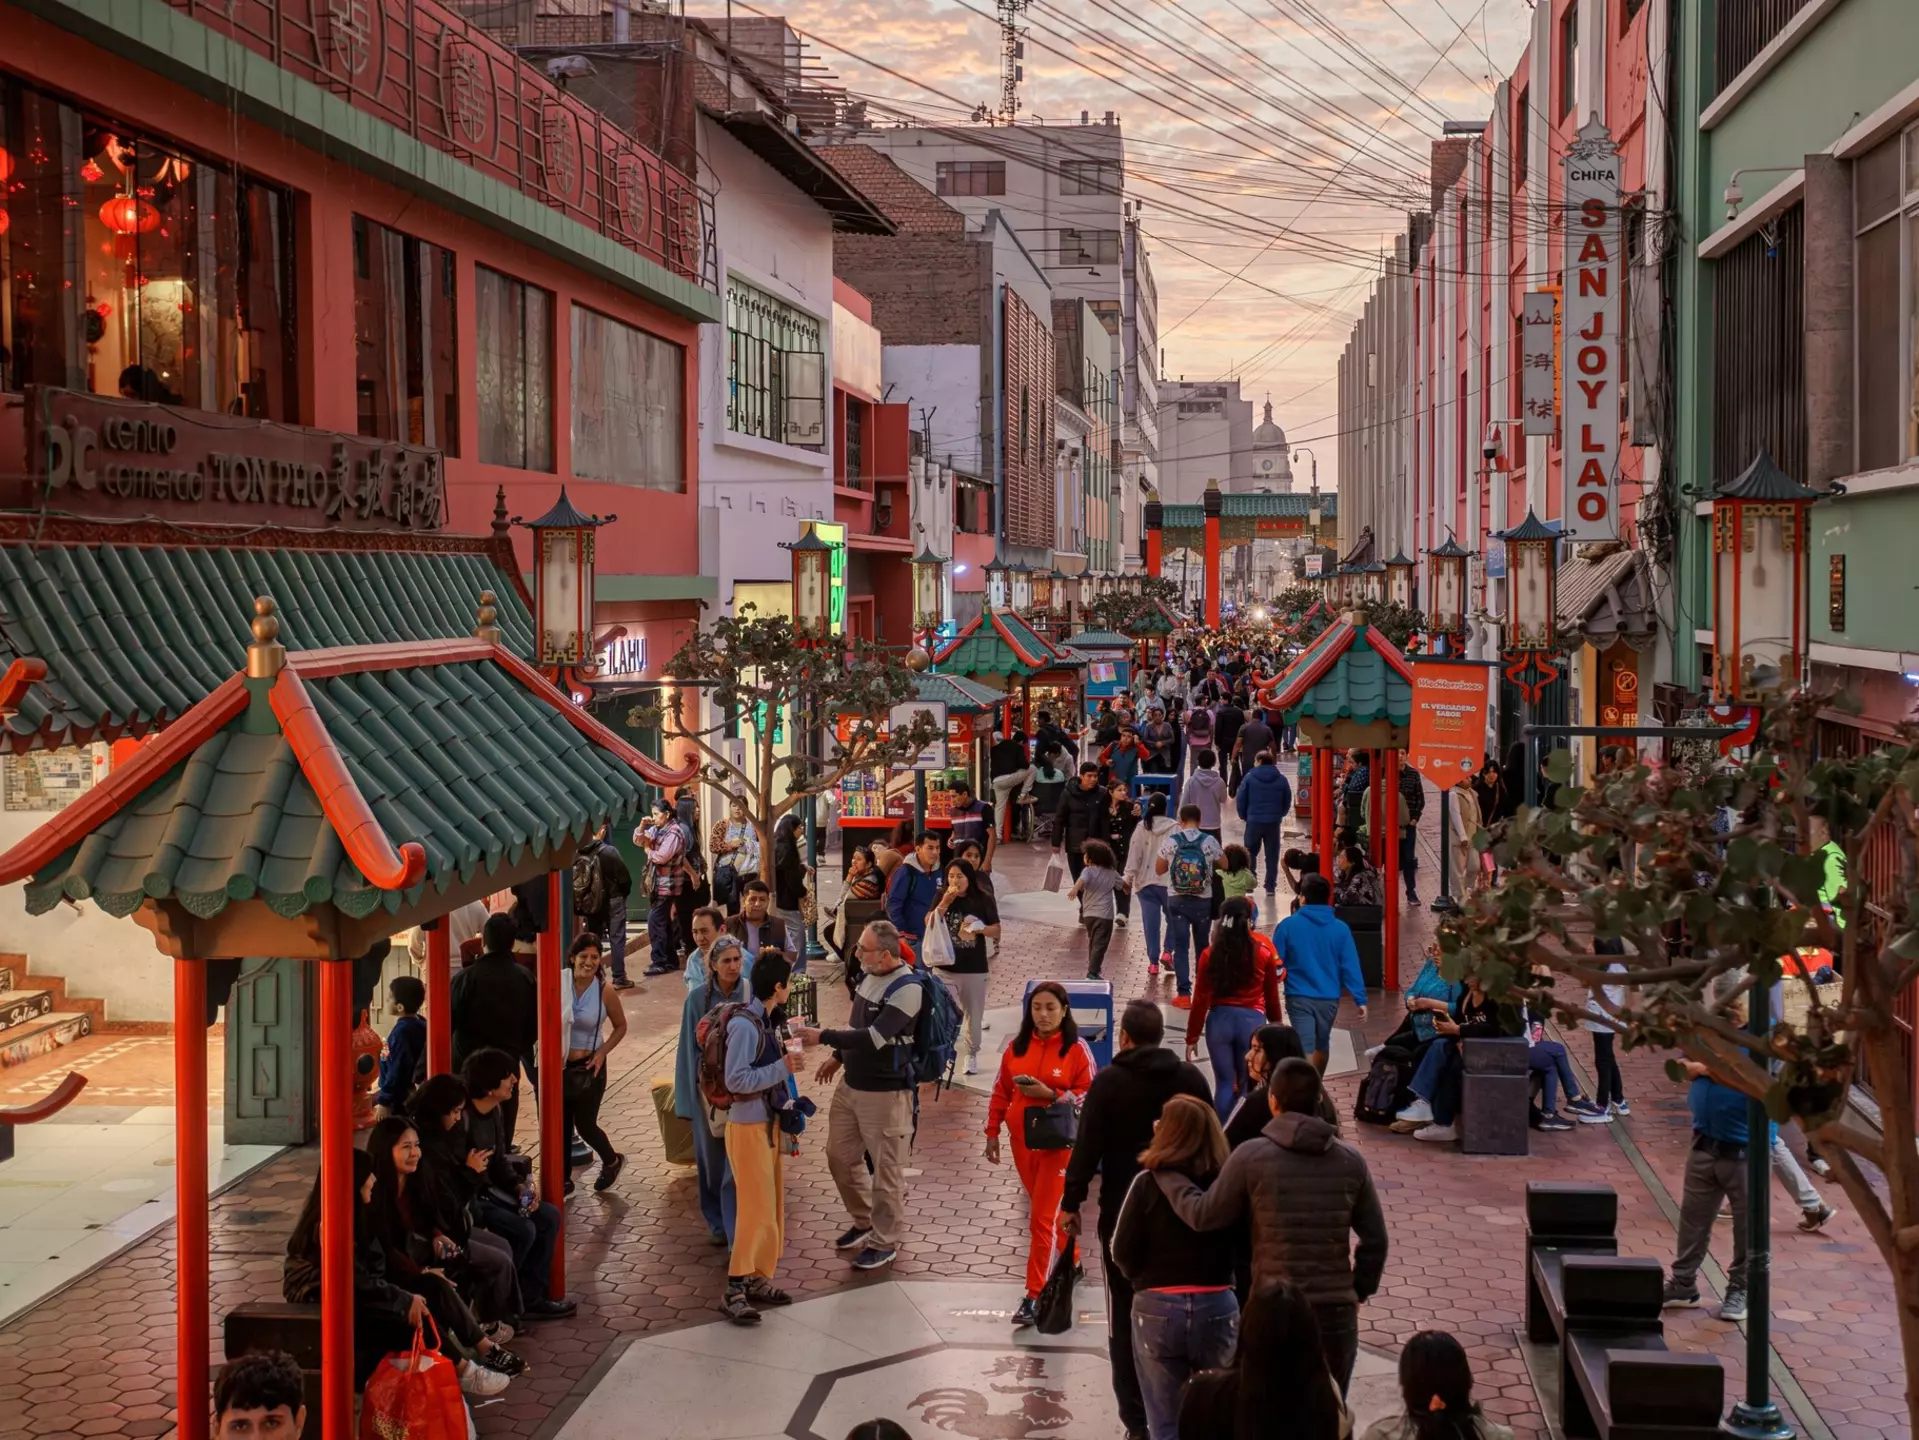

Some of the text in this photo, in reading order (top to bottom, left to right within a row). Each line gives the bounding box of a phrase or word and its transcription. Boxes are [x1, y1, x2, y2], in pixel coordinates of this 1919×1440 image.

[1570, 169, 1615, 182] CHIFA
[1577, 198, 1608, 522] SAN JOY LAO
[103, 414, 178, 454] centro
[103, 462, 205, 502] comercial
[208, 451, 328, 508] TON PHO
[1431, 703, 1477, 712] VERDADERO
